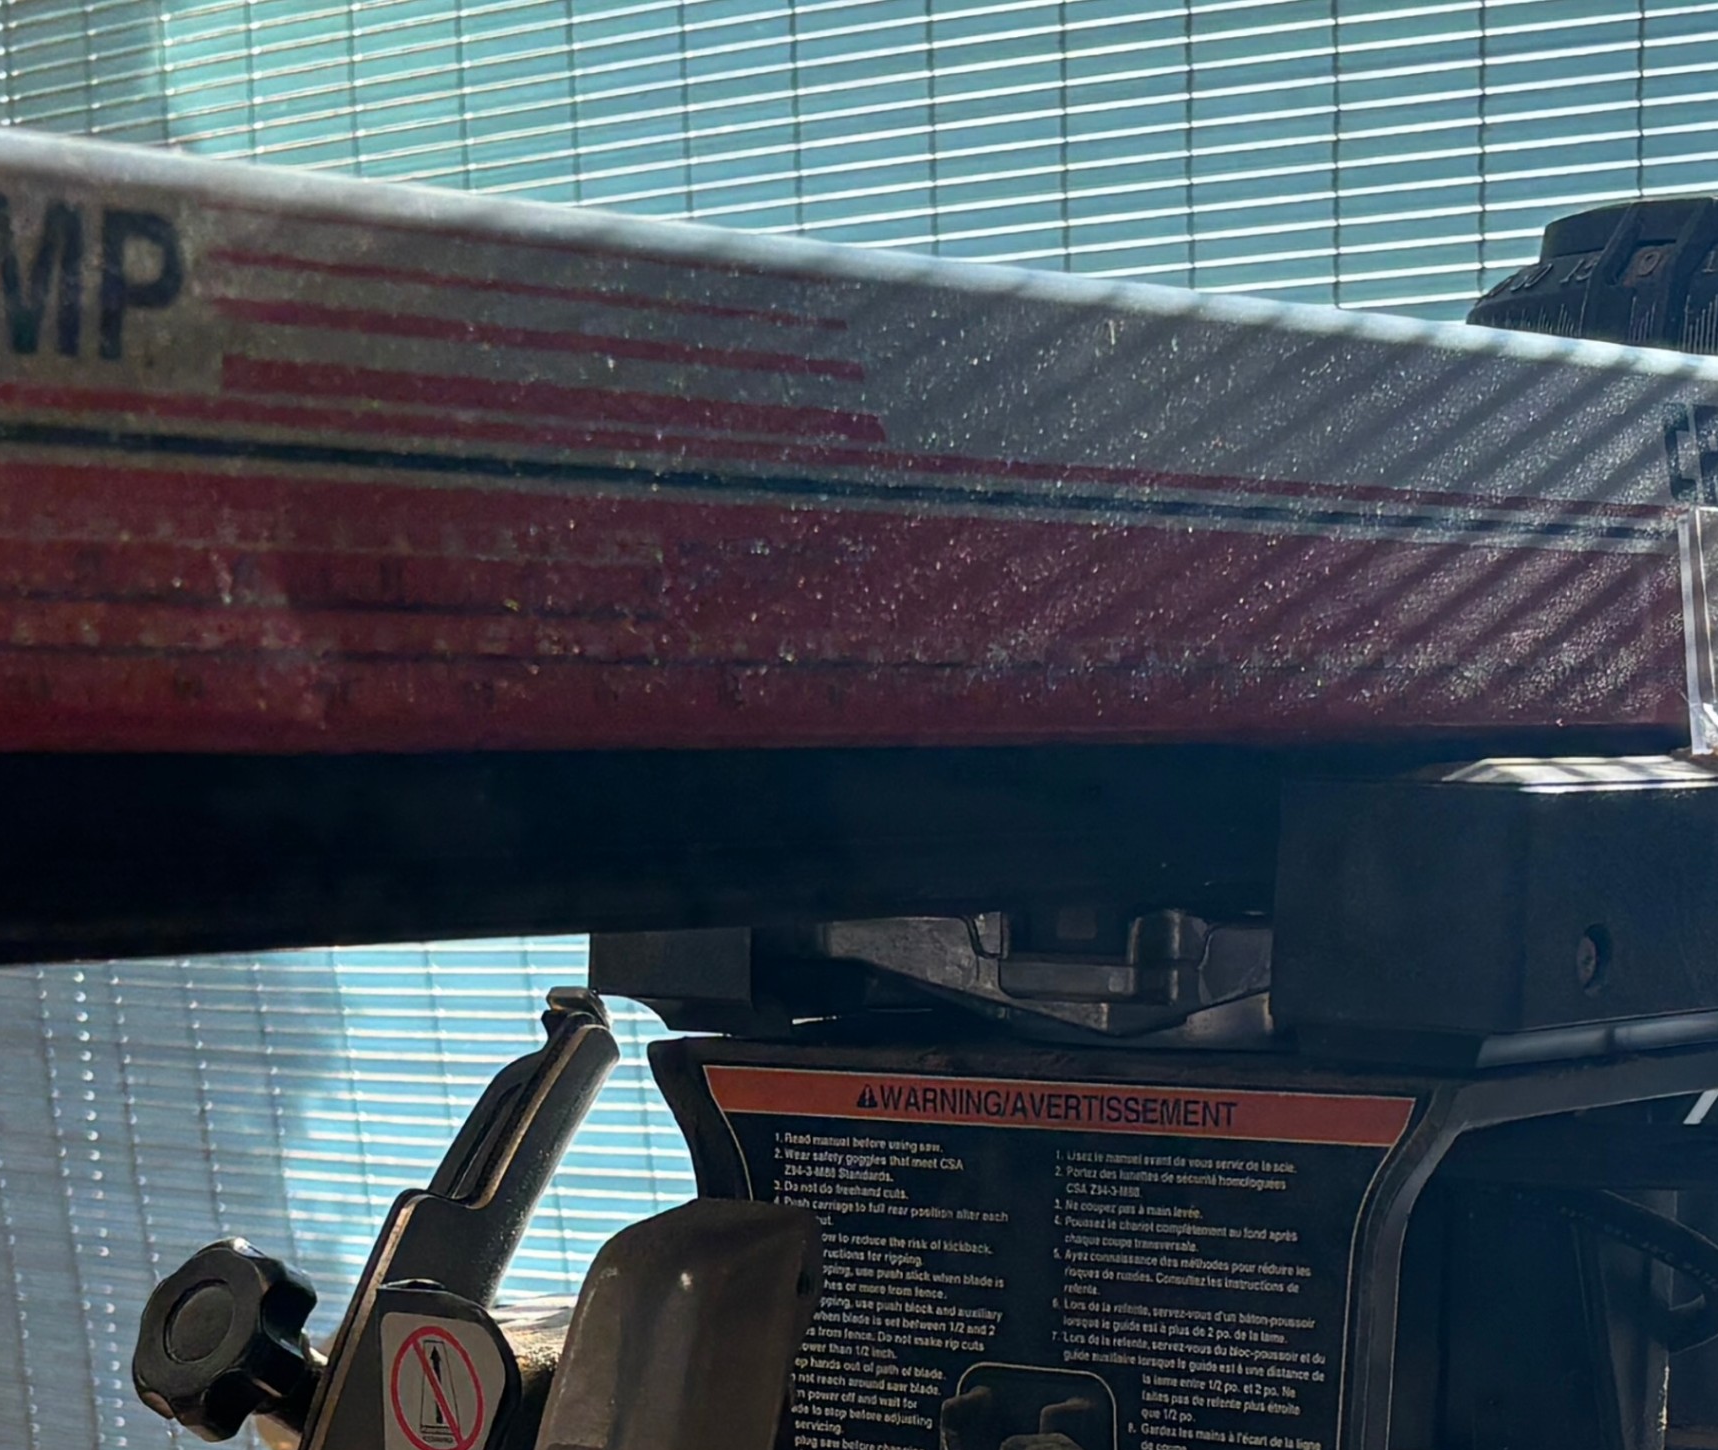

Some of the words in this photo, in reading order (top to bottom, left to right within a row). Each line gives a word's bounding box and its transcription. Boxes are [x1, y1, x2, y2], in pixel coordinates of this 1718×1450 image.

[882, 1084, 1238, 1127] WARNING/AVERTISSEMENT
[852, 1136, 886, 1149] before
[845, 1154, 886, 1167] goggles
[889, 1155, 909, 1166] that
[812, 1200, 853, 1213] carriage
[868, 1201, 885, 1213] full
[982, 1211, 1008, 1221] each
[850, 1235, 886, 1246] reduce
[907, 1238, 927, 1249] risk
[876, 1268, 903, 1279] push
[905, 1269, 930, 1281] stick
[932, 1272, 961, 1284] when
[963, 1274, 992, 1287] blade
[858, 1283, 886, 1294] more
[887, 1284, 912, 1296] from
[876, 1300, 902, 1312] push
[904, 1301, 933, 1314] block
[842, 1312, 870, 1325] blade
[902, 1317, 946, 1331] between
[818, 1325, 842, 1338] from
[913, 1336, 942, 1347] make
[1168, 1324, 1189, 1336] plus
[828, 1342, 852, 1354] than
[810, 1356, 841, 1370] hands
[875, 1364, 898, 1376] path
[1266, 1365, 1309, 1380] distance
[816, 1375, 845, 1386] reach
[848, 1377, 884, 1390] around
[807, 1390, 839, 1401] power
[879, 1397, 900, 1407] wait
[1243, 1399, 1265, 1413] plus
[824, 1407, 846, 1420] stop
[848, 1408, 882, 1421] before
[883, 1412, 932, 1429] adjusting
